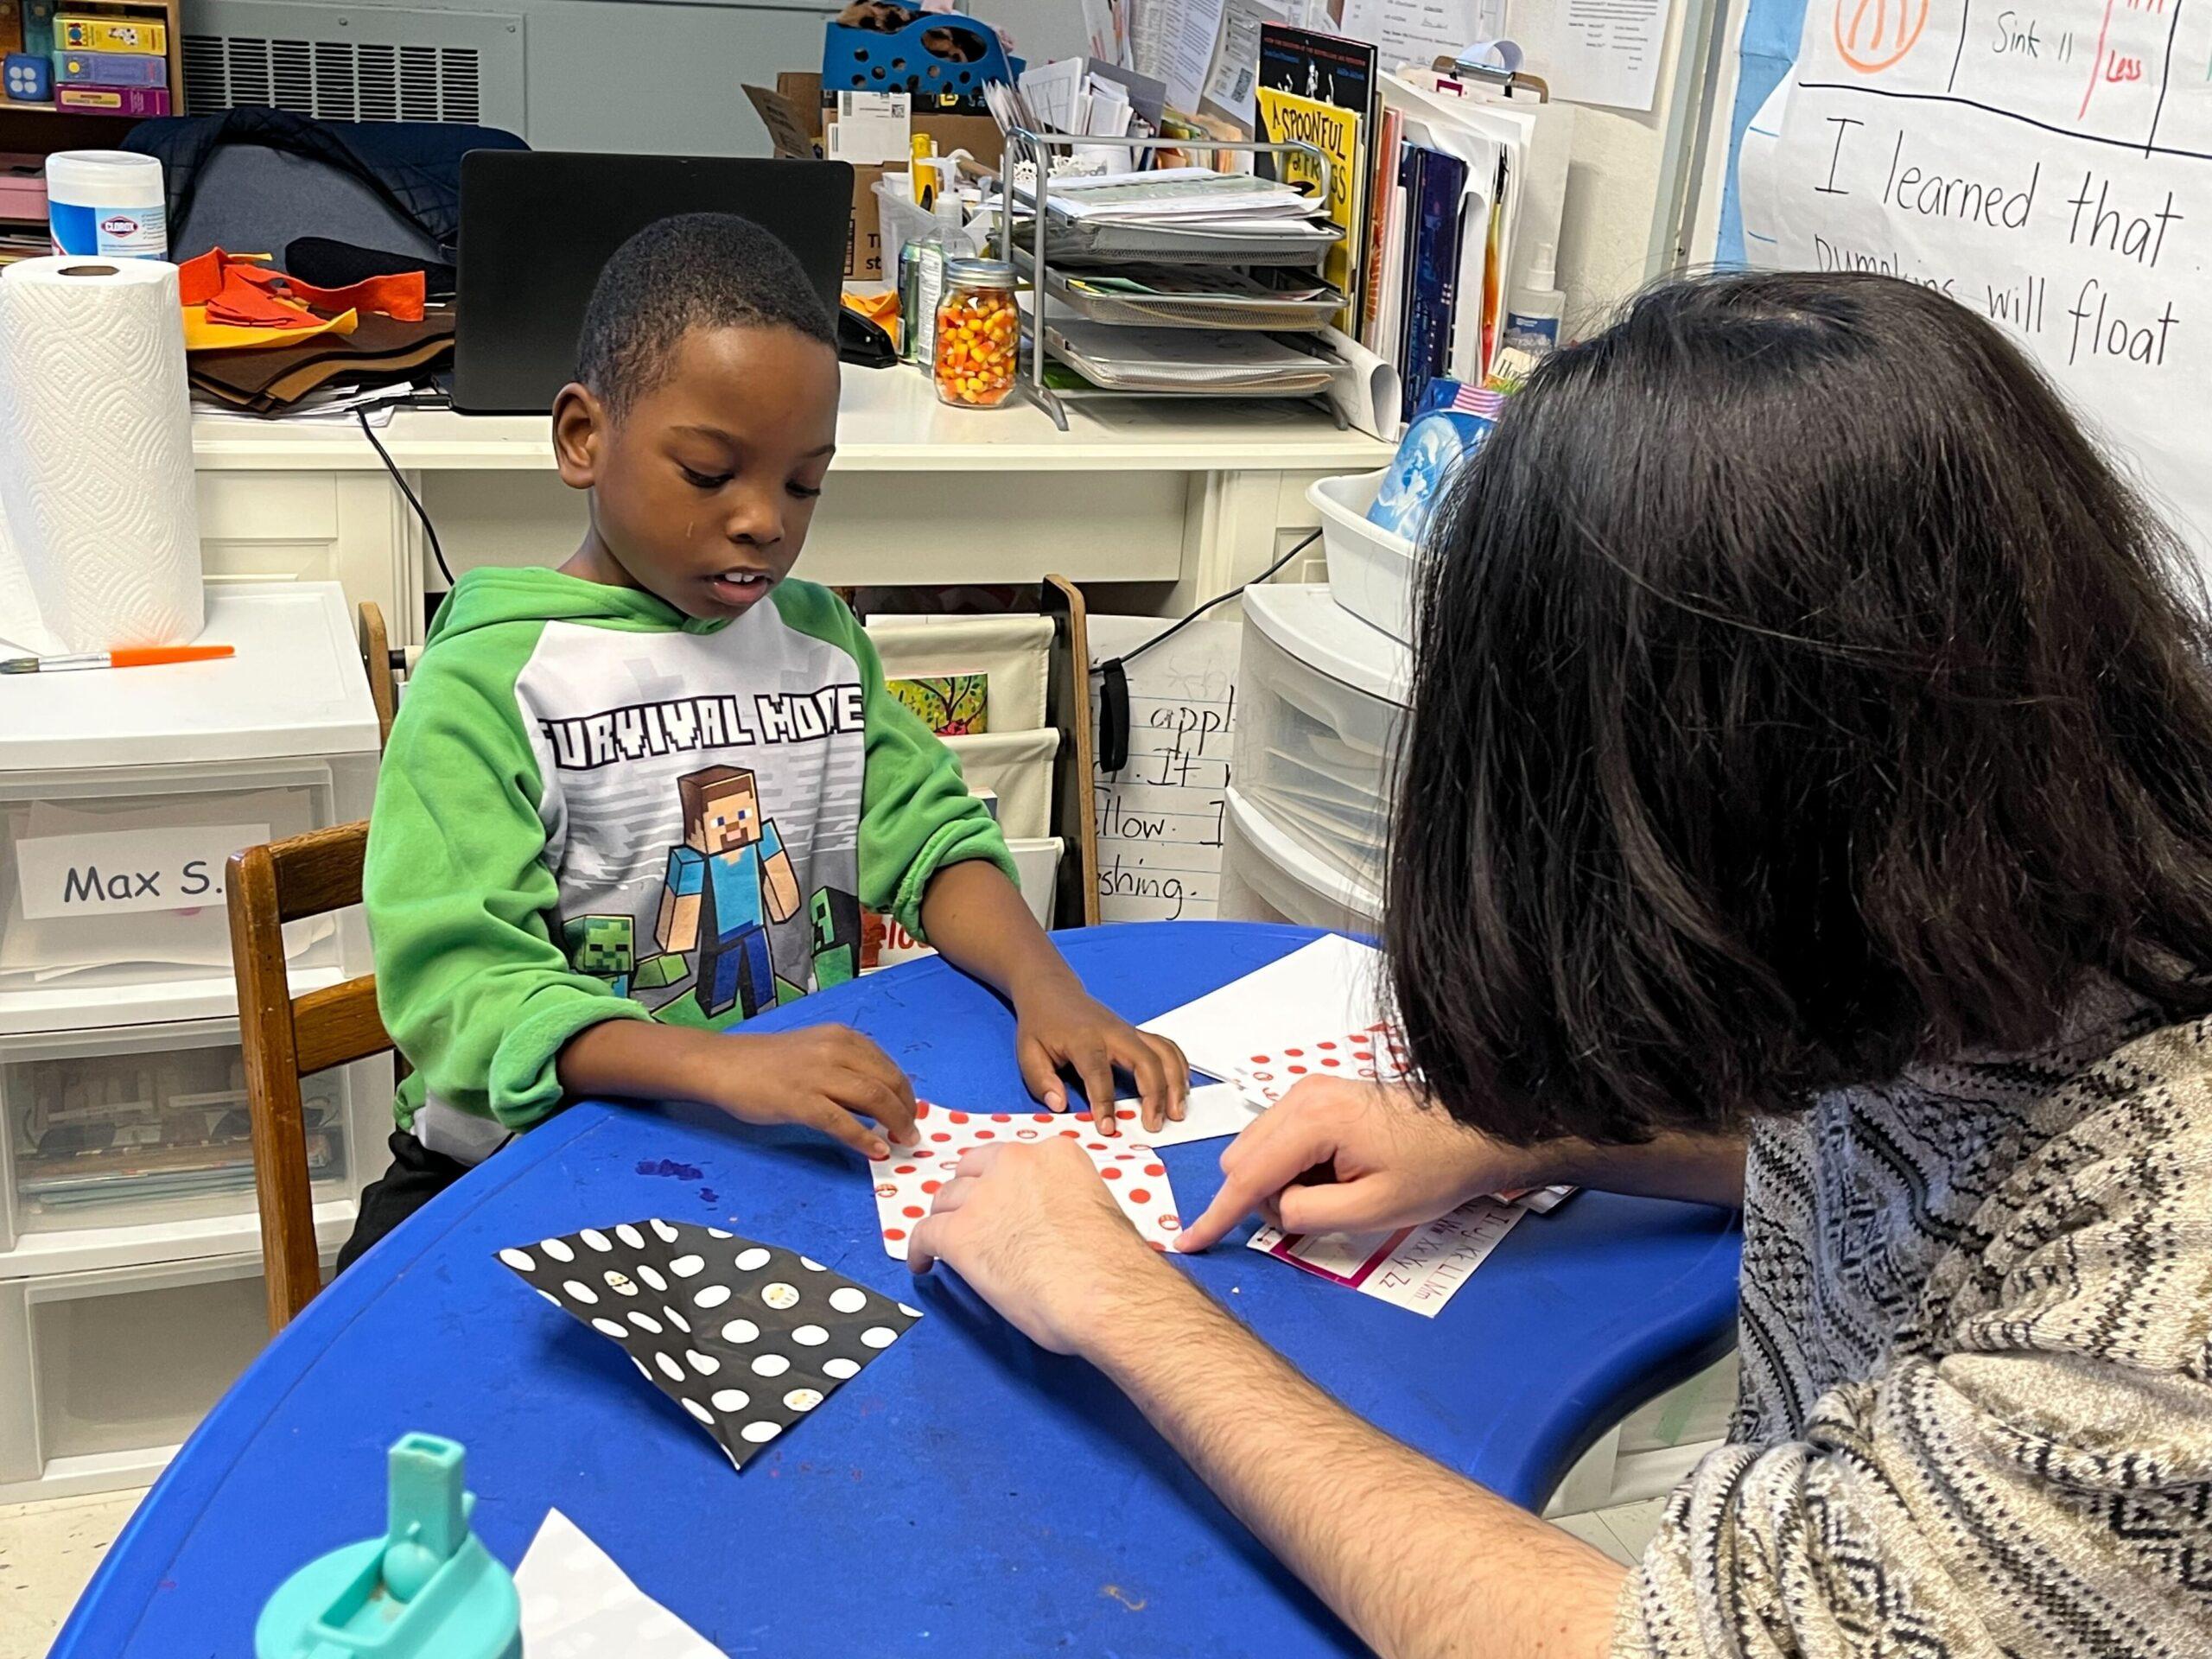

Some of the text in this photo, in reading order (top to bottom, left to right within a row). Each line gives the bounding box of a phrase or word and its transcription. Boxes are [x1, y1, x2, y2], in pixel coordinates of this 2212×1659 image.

[1993, 11, 2040, 58] Sink
[1272, 99, 1347, 161] A SPOONFUL
[1302, 152, 1347, 205] FRGS
[1815, 117, 2184, 267] I learned that
[1986, 275, 2045, 333] will
[2068, 278, 2181, 365] float
[1150, 685, 1236, 760] appl
[64, 861, 223, 902] Max S.
[1098, 854, 1198, 920] shing.
